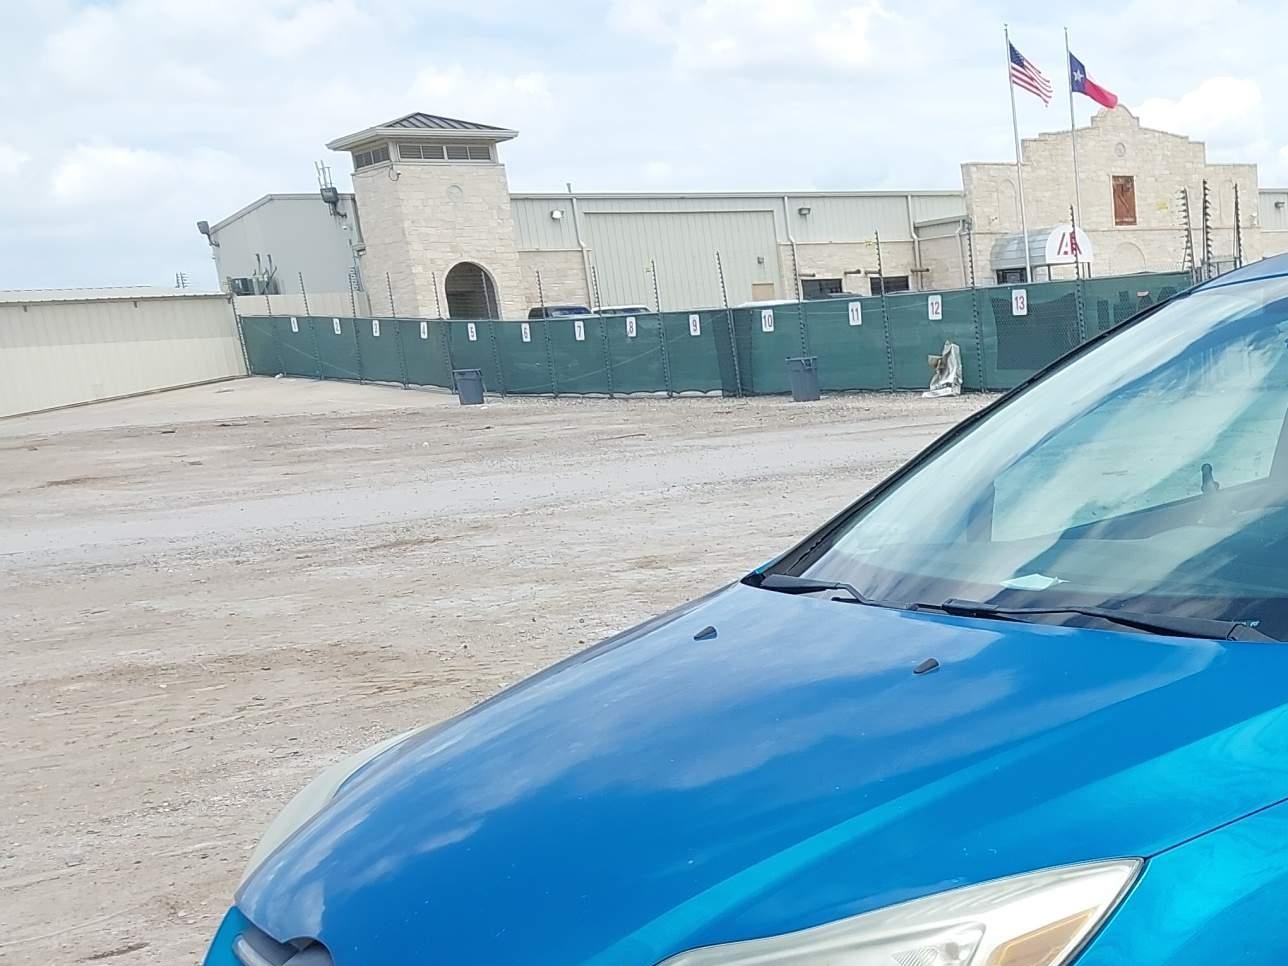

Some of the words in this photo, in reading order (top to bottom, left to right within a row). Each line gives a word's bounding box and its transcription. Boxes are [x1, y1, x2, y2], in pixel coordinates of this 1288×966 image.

[931, 301, 940, 315] 12
[1015, 296, 1025, 311] 13
[763, 313, 773, 327] 10
[851, 308, 859, 321] 11
[577, 326, 582, 338] 7
[629, 322, 634, 334] 8
[692, 319, 698, 332] 9
